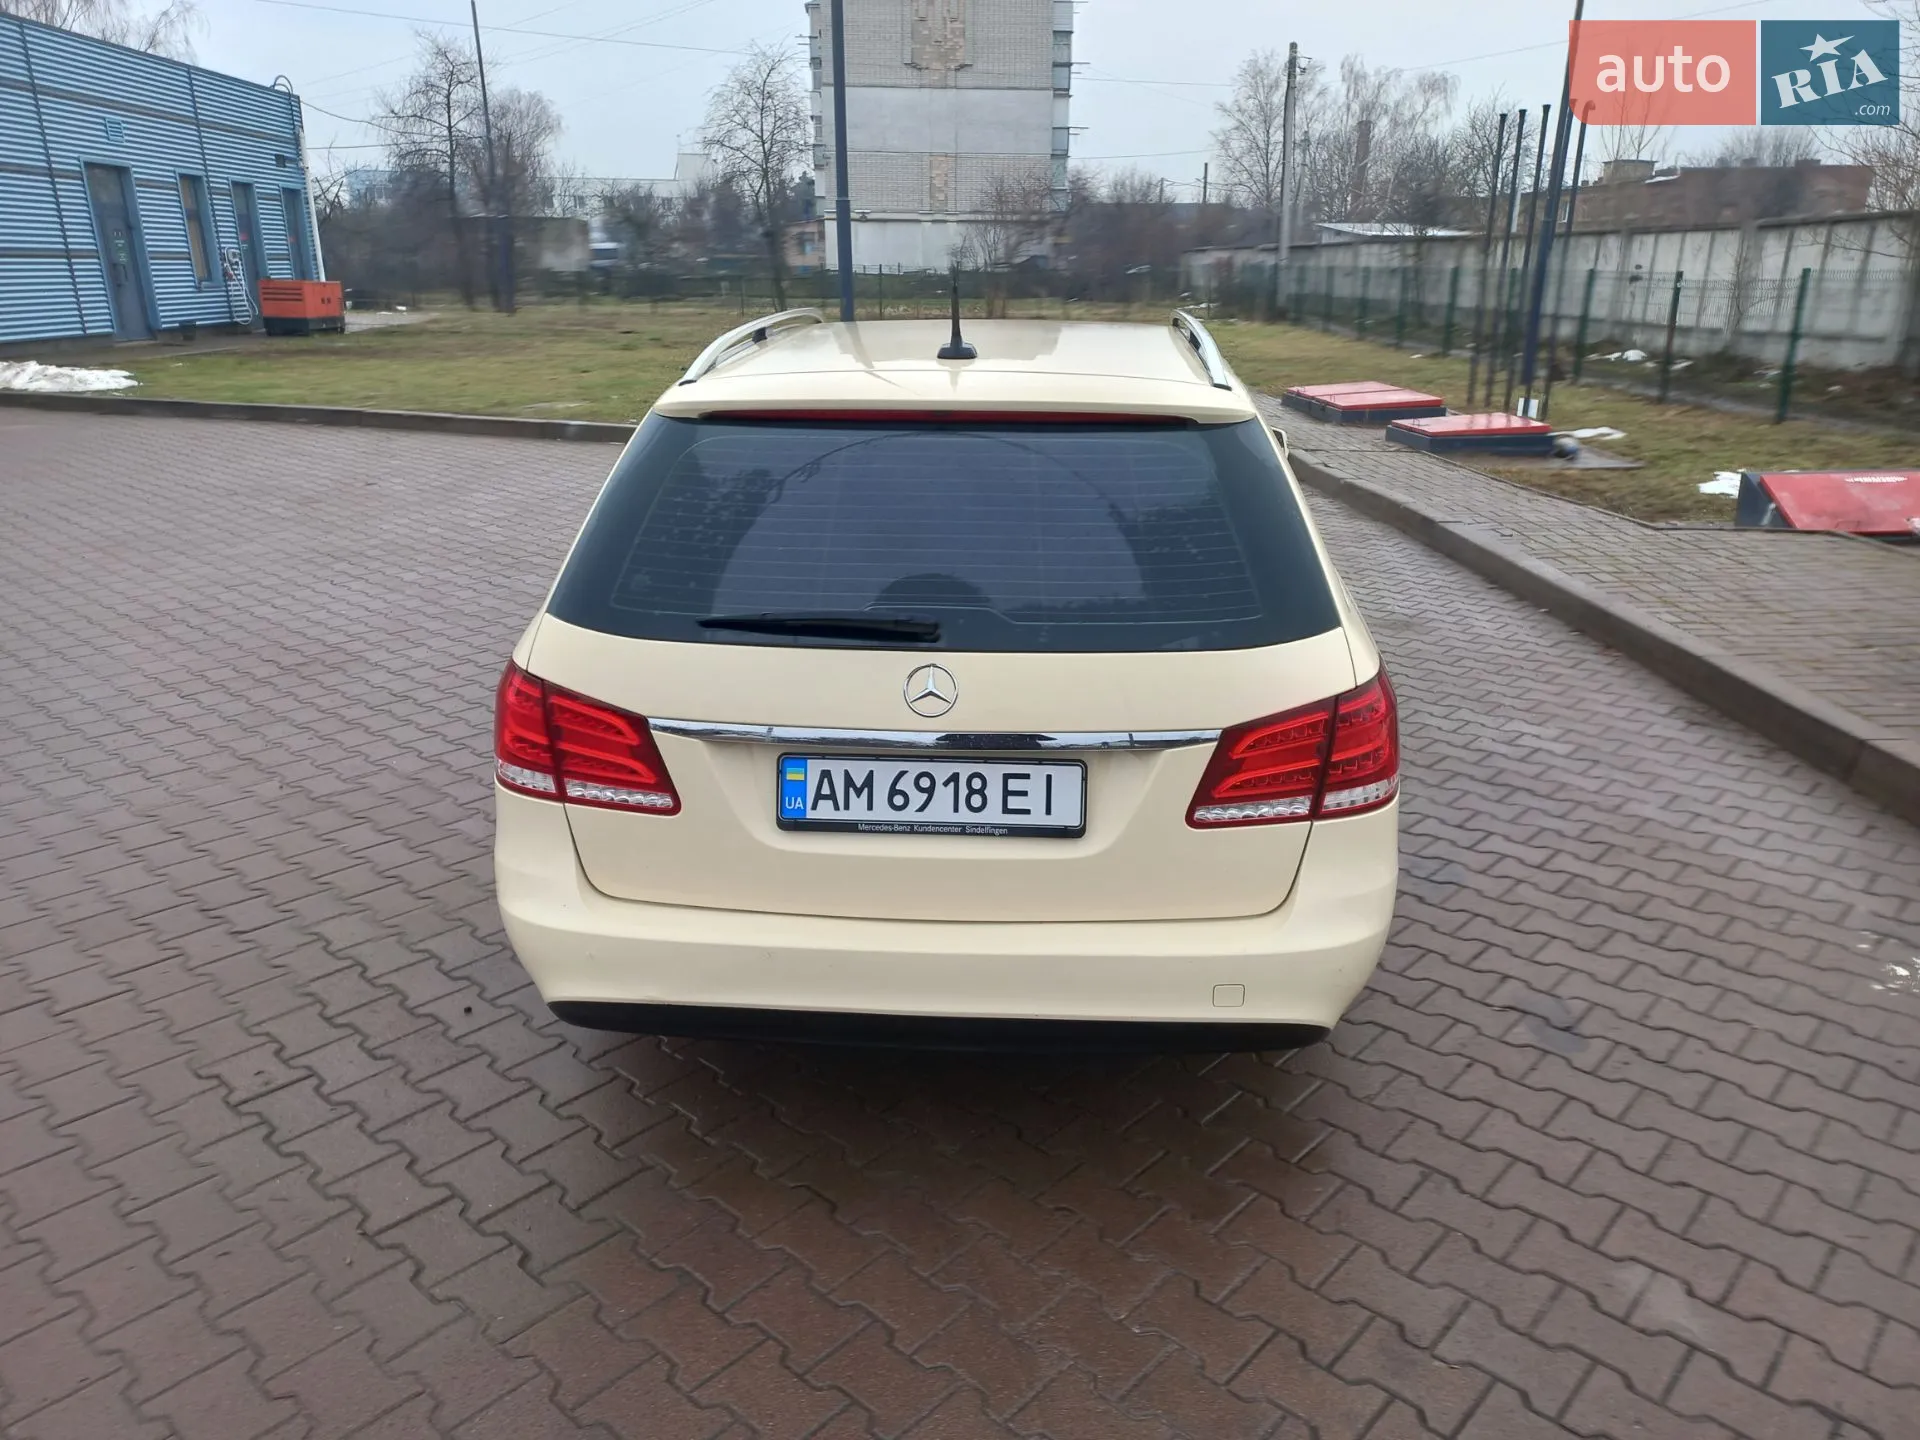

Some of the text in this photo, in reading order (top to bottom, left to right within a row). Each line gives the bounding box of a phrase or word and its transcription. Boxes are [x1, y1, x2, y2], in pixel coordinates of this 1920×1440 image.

[811, 769, 1052, 816] AM 6918 EI
[785, 797, 804, 810] UA
[858, 823, 1008, 836] Mercedes-Benz Kundencenter Sindelfingen
